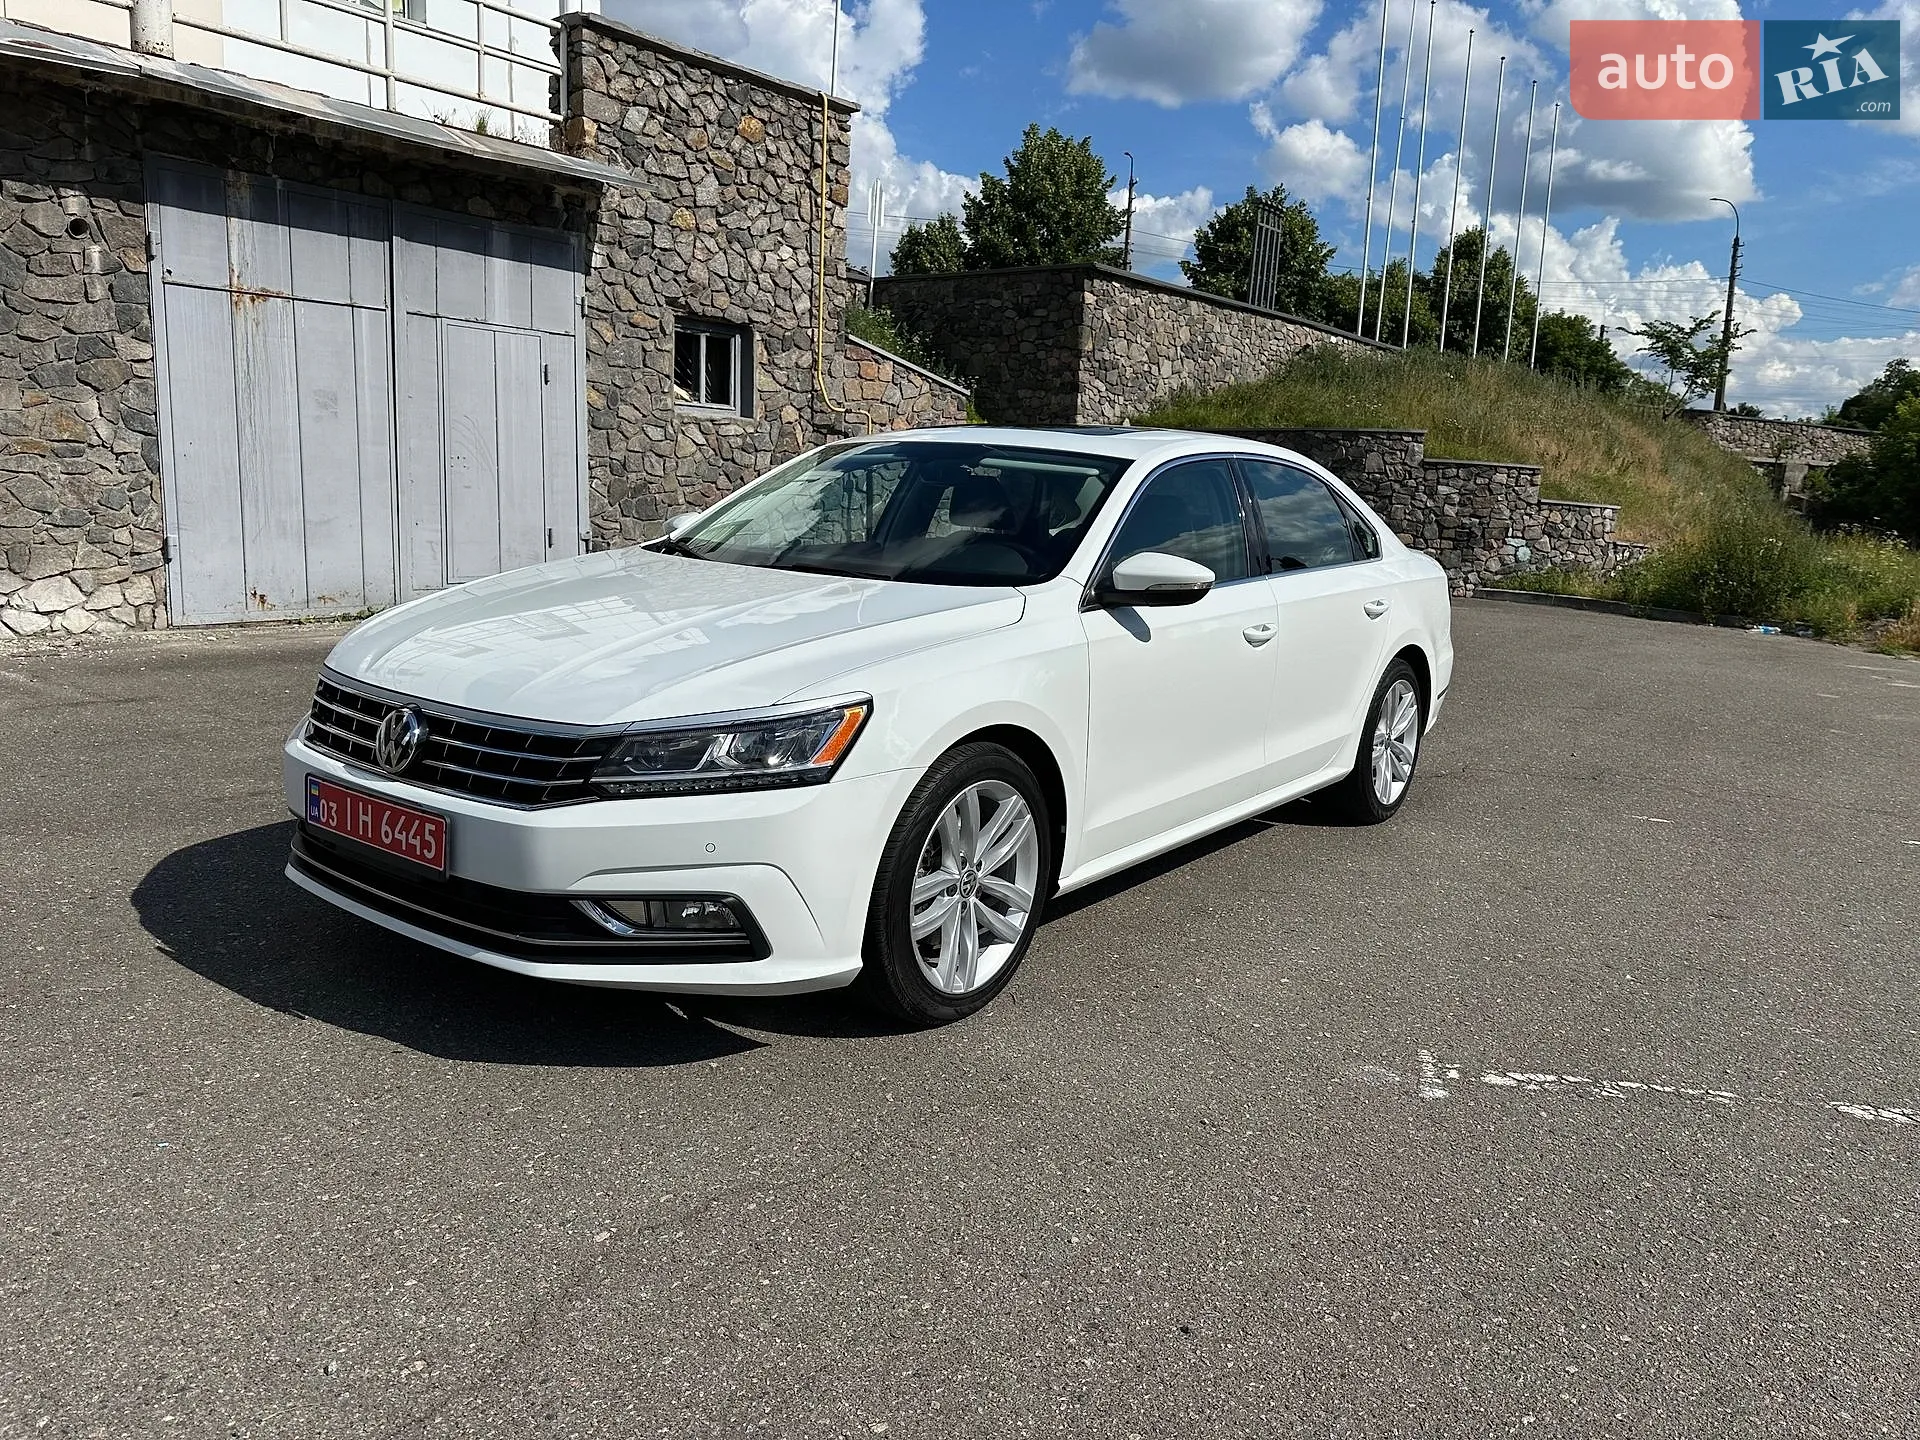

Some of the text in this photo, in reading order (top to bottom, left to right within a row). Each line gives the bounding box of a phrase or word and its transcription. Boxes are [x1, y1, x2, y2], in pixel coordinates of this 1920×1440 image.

[310, 805, 319, 818] UA
[319, 797, 436, 859] 03 IH 6445
